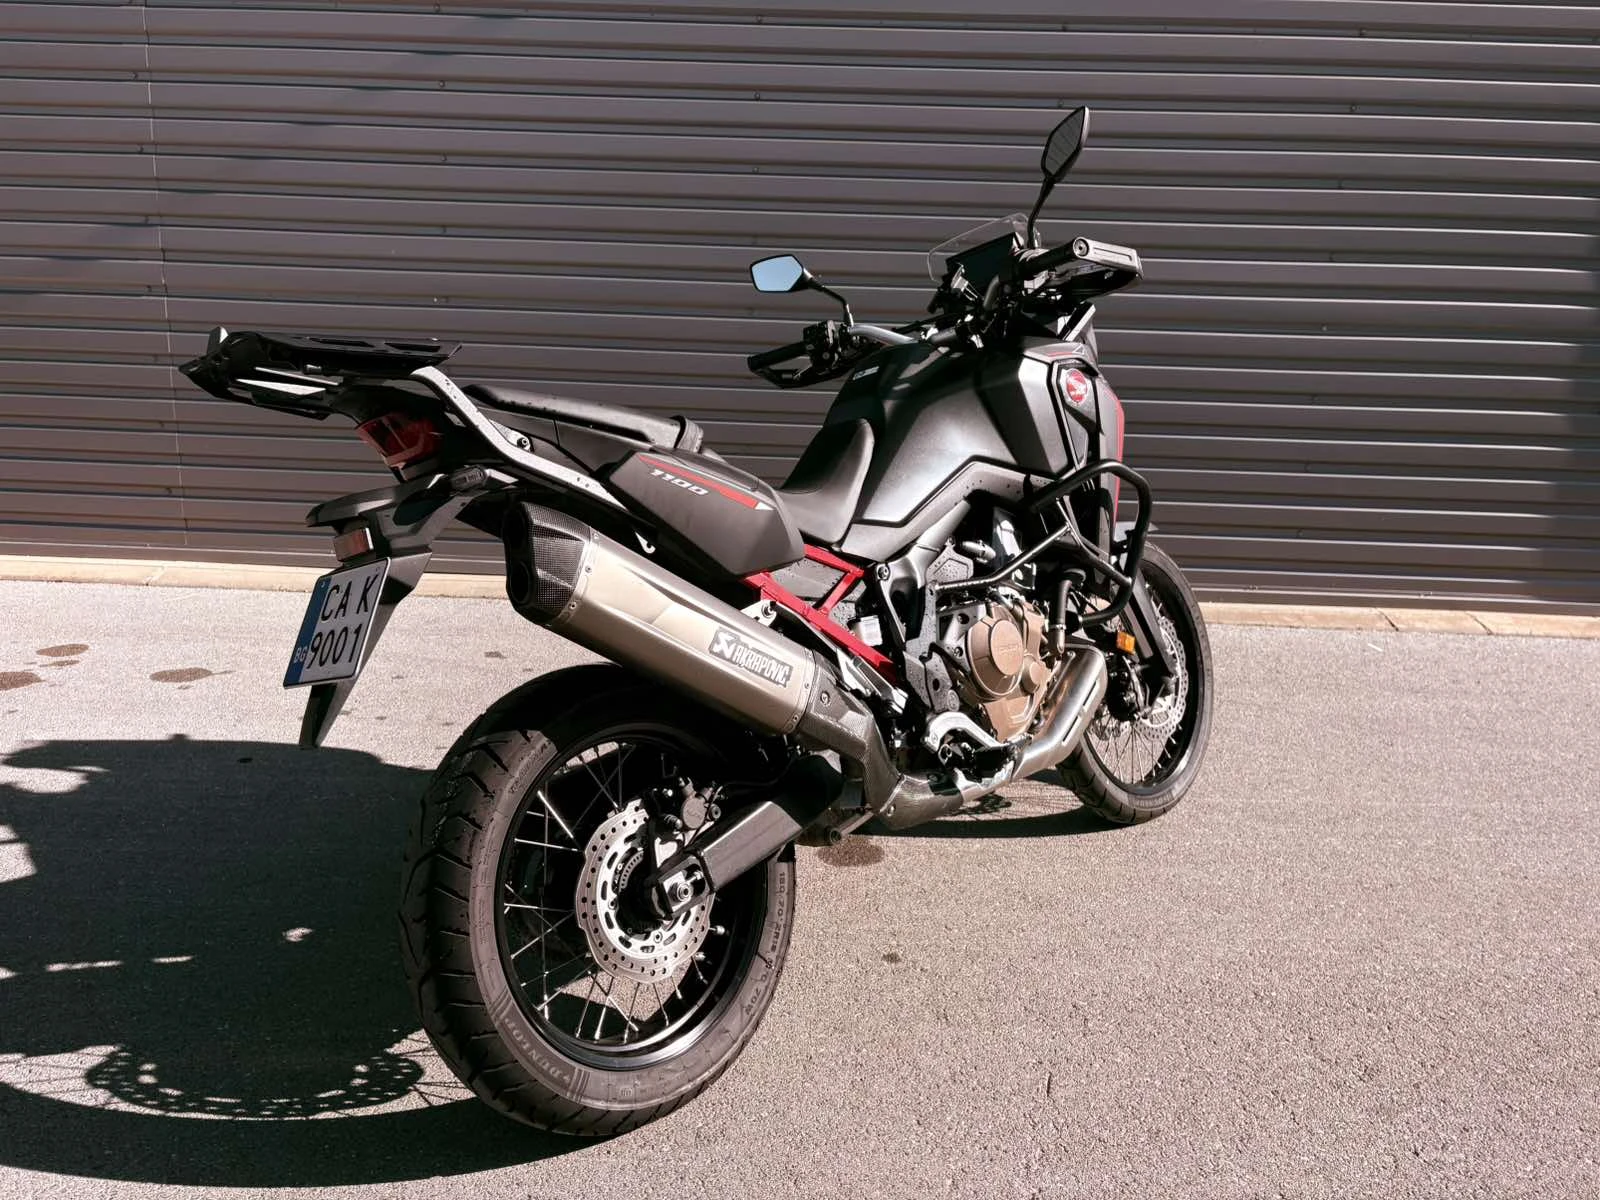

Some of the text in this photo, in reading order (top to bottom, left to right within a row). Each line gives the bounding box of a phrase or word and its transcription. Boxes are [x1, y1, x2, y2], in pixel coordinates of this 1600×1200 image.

[650, 468, 709, 495] 1100
[321, 574, 378, 621] CA K
[307, 624, 362, 669] 9001
[504, 1018, 562, 1078] DUNLOP
